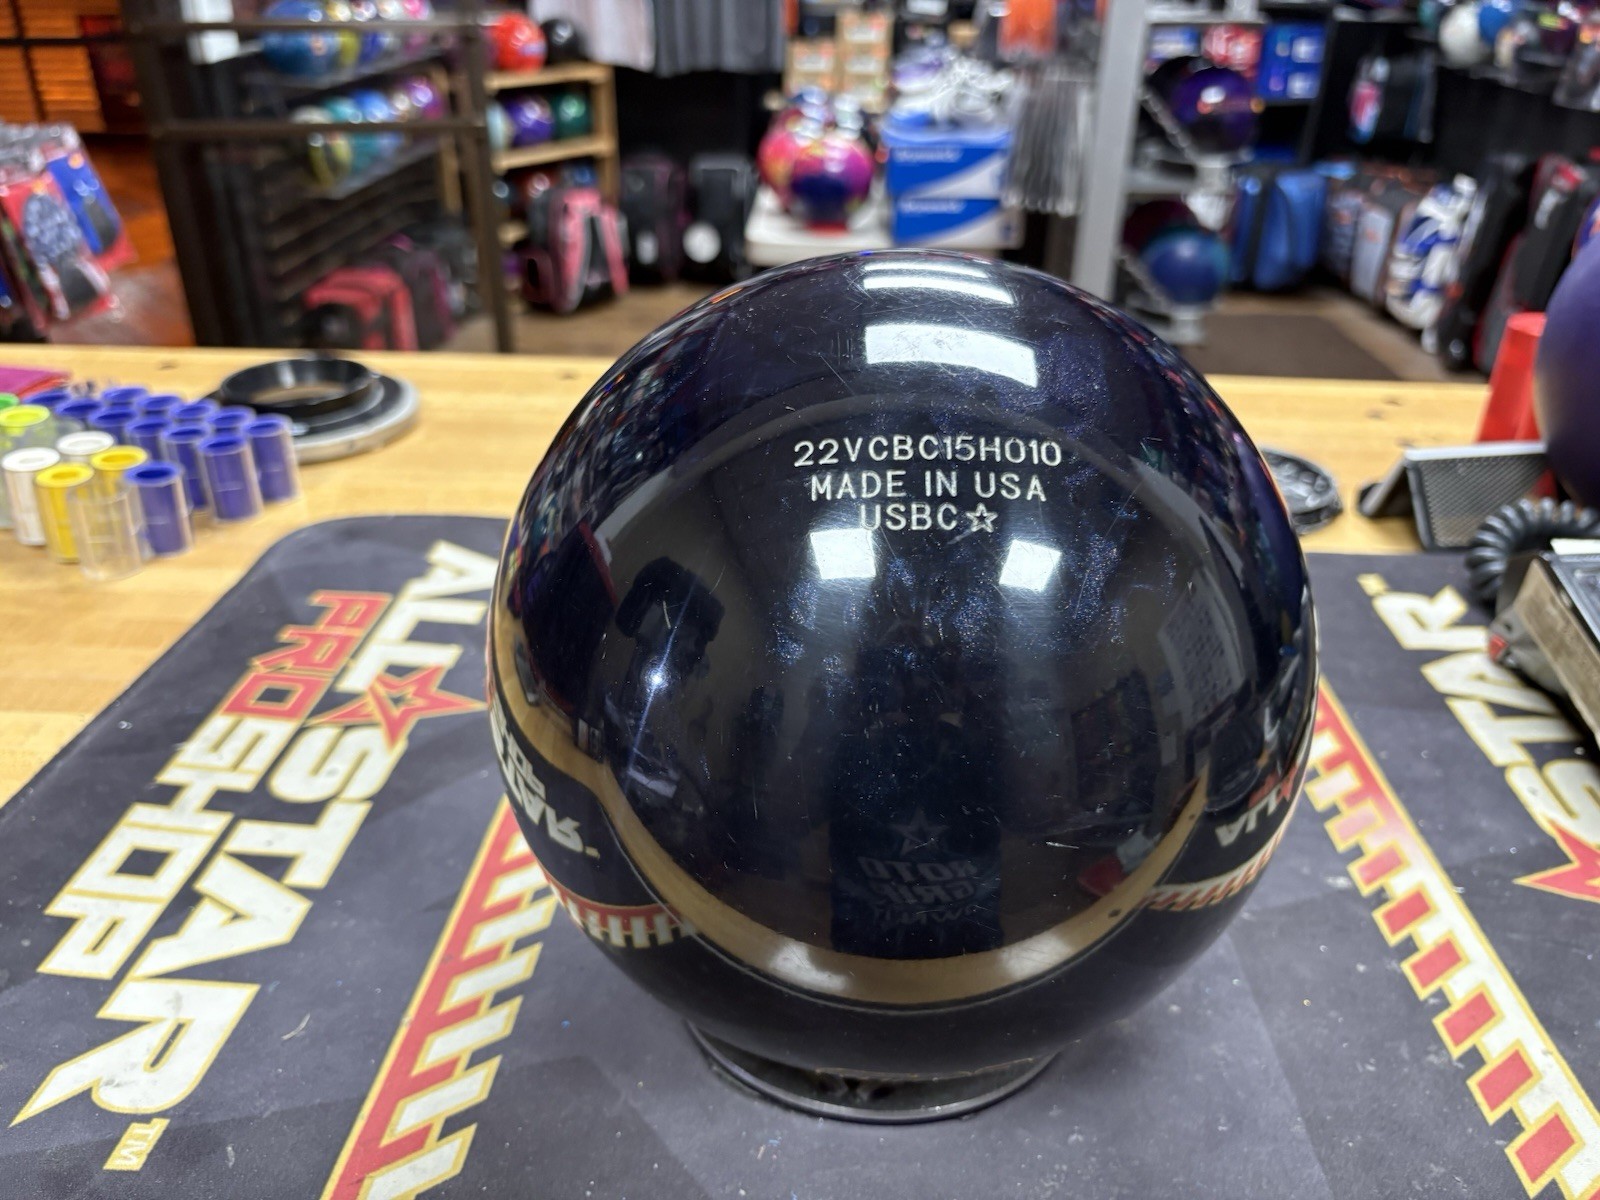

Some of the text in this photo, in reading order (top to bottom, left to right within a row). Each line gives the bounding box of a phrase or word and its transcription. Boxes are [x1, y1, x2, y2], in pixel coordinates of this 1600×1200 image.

[810, 469, 1047, 502] MADE IN USA
[860, 503, 958, 531] USBC
[36, 590, 393, 981] PRO SHOP
